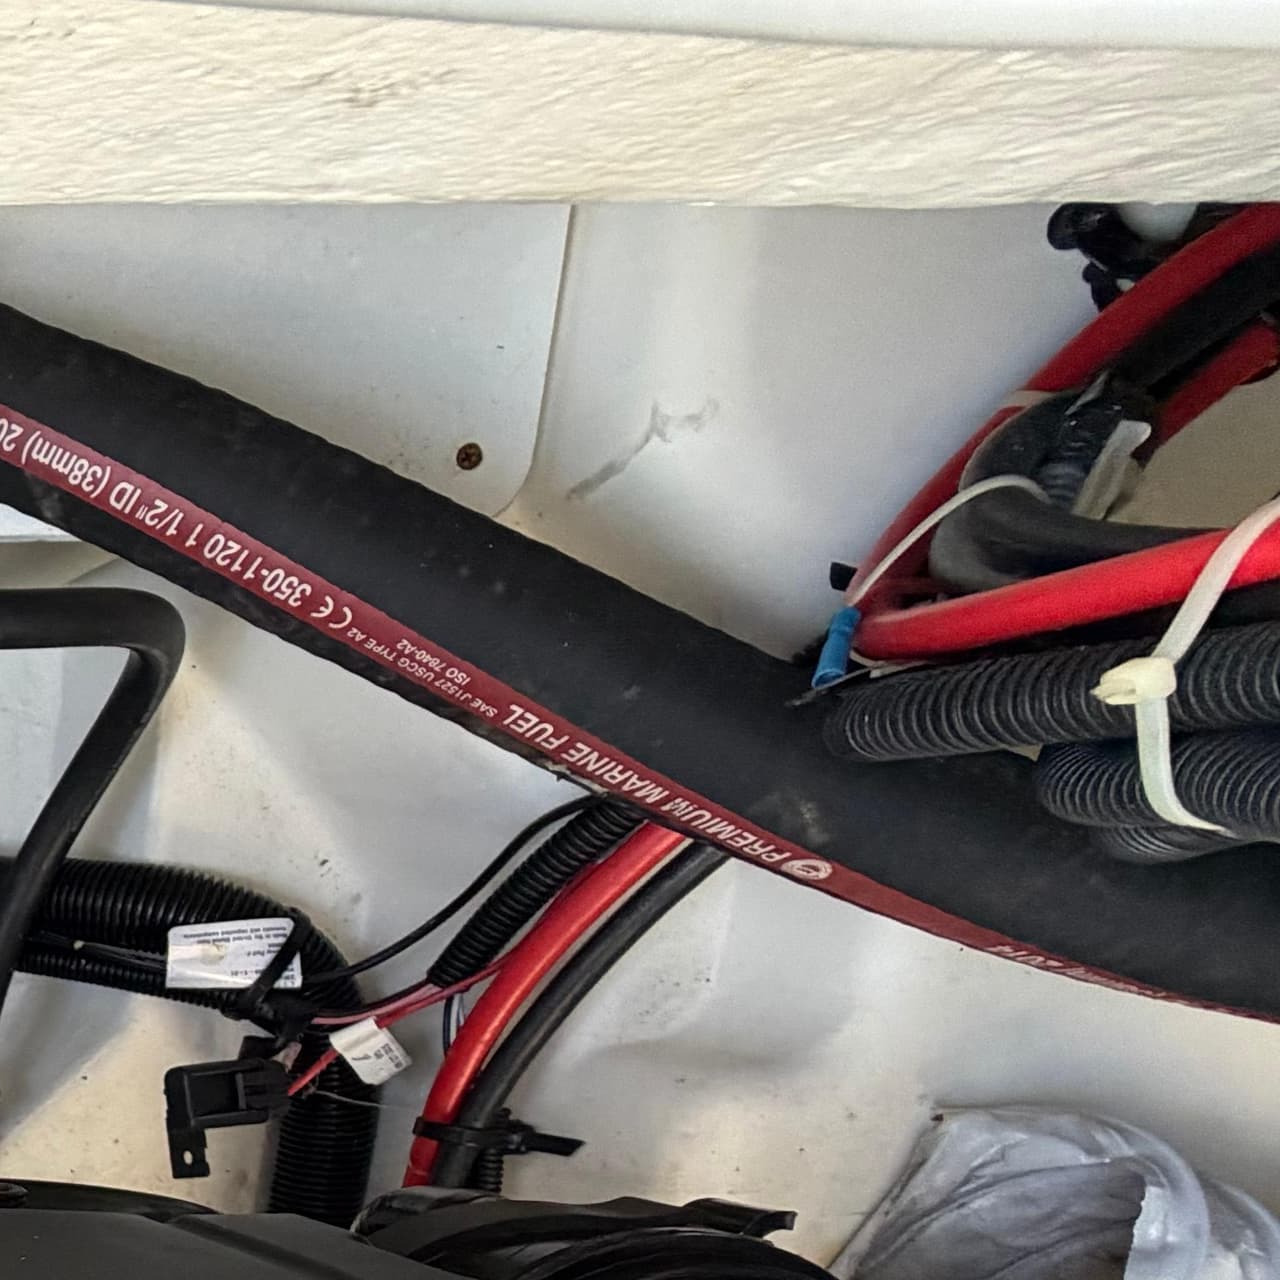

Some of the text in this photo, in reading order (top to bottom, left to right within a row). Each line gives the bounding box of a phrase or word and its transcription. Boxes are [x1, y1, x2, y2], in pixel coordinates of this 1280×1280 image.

[21, 430, 112, 498] (38mm)
[109, 481, 142, 514] ID
[135, 498, 184, 536] 1/2"
[185, 523, 204, 547] 1
[203, 533, 312, 607] 350-1120
[502, 704, 790, 870] PREMIUM MARINE FUEL
